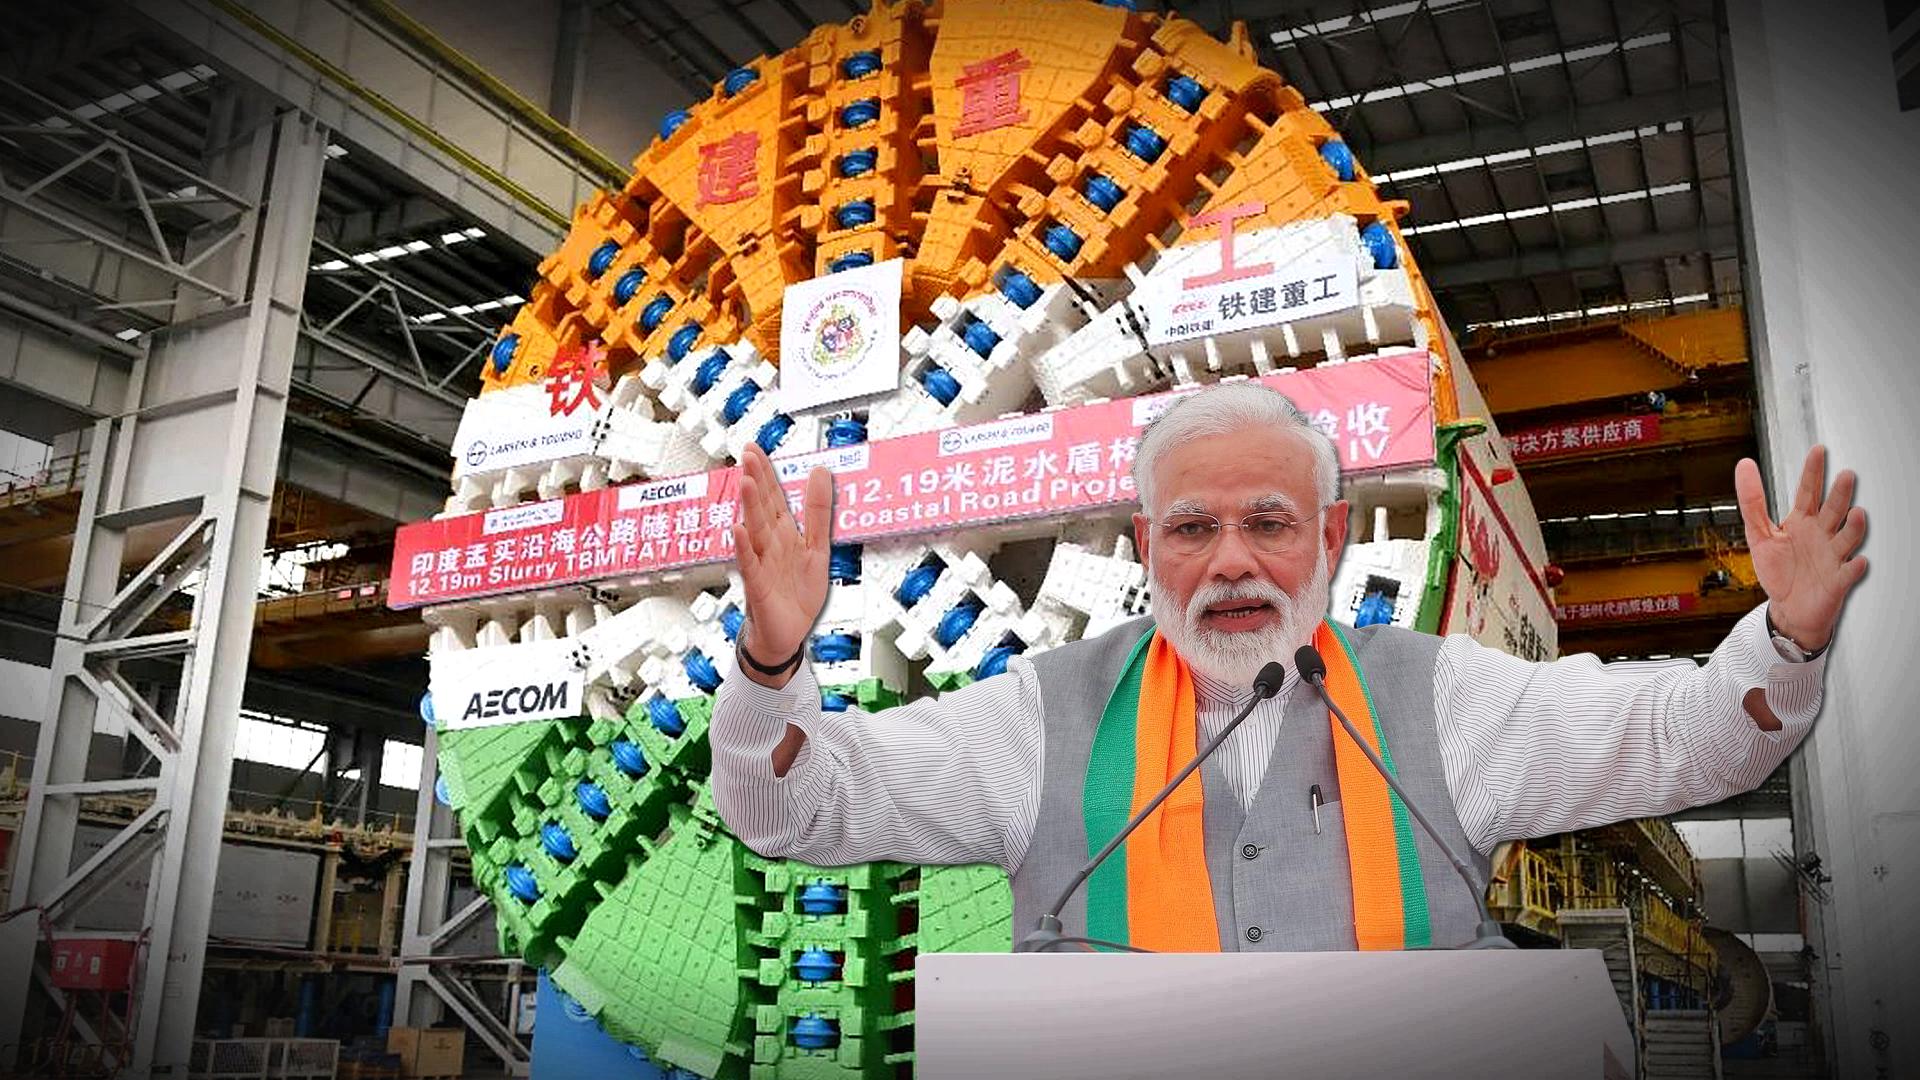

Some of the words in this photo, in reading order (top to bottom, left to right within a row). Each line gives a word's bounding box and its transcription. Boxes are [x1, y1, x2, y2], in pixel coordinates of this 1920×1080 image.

[545, 338, 609, 417] 铁
[695, 131, 759, 207] 建
[953, 48, 1030, 140] 重
[1182, 200, 1275, 291] 工
[1218, 274, 1341, 320] 铁建重工
[408, 571, 481, 597] 12.19m
[488, 561, 558, 585] Slurry
[565, 549, 616, 572] TBM
[623, 538, 673, 563] FAT
[678, 535, 711, 555] for
[838, 496, 950, 531] Coastal
[960, 480, 1042, 513] Road
[1050, 471, 1137, 501] Proje
[1349, 434, 1390, 463] IV
[640, 482, 687, 502] AECOM
[411, 500, 744, 577] 印度孟买沿海公路隧道第
[462, 680, 568, 721] AECOM
